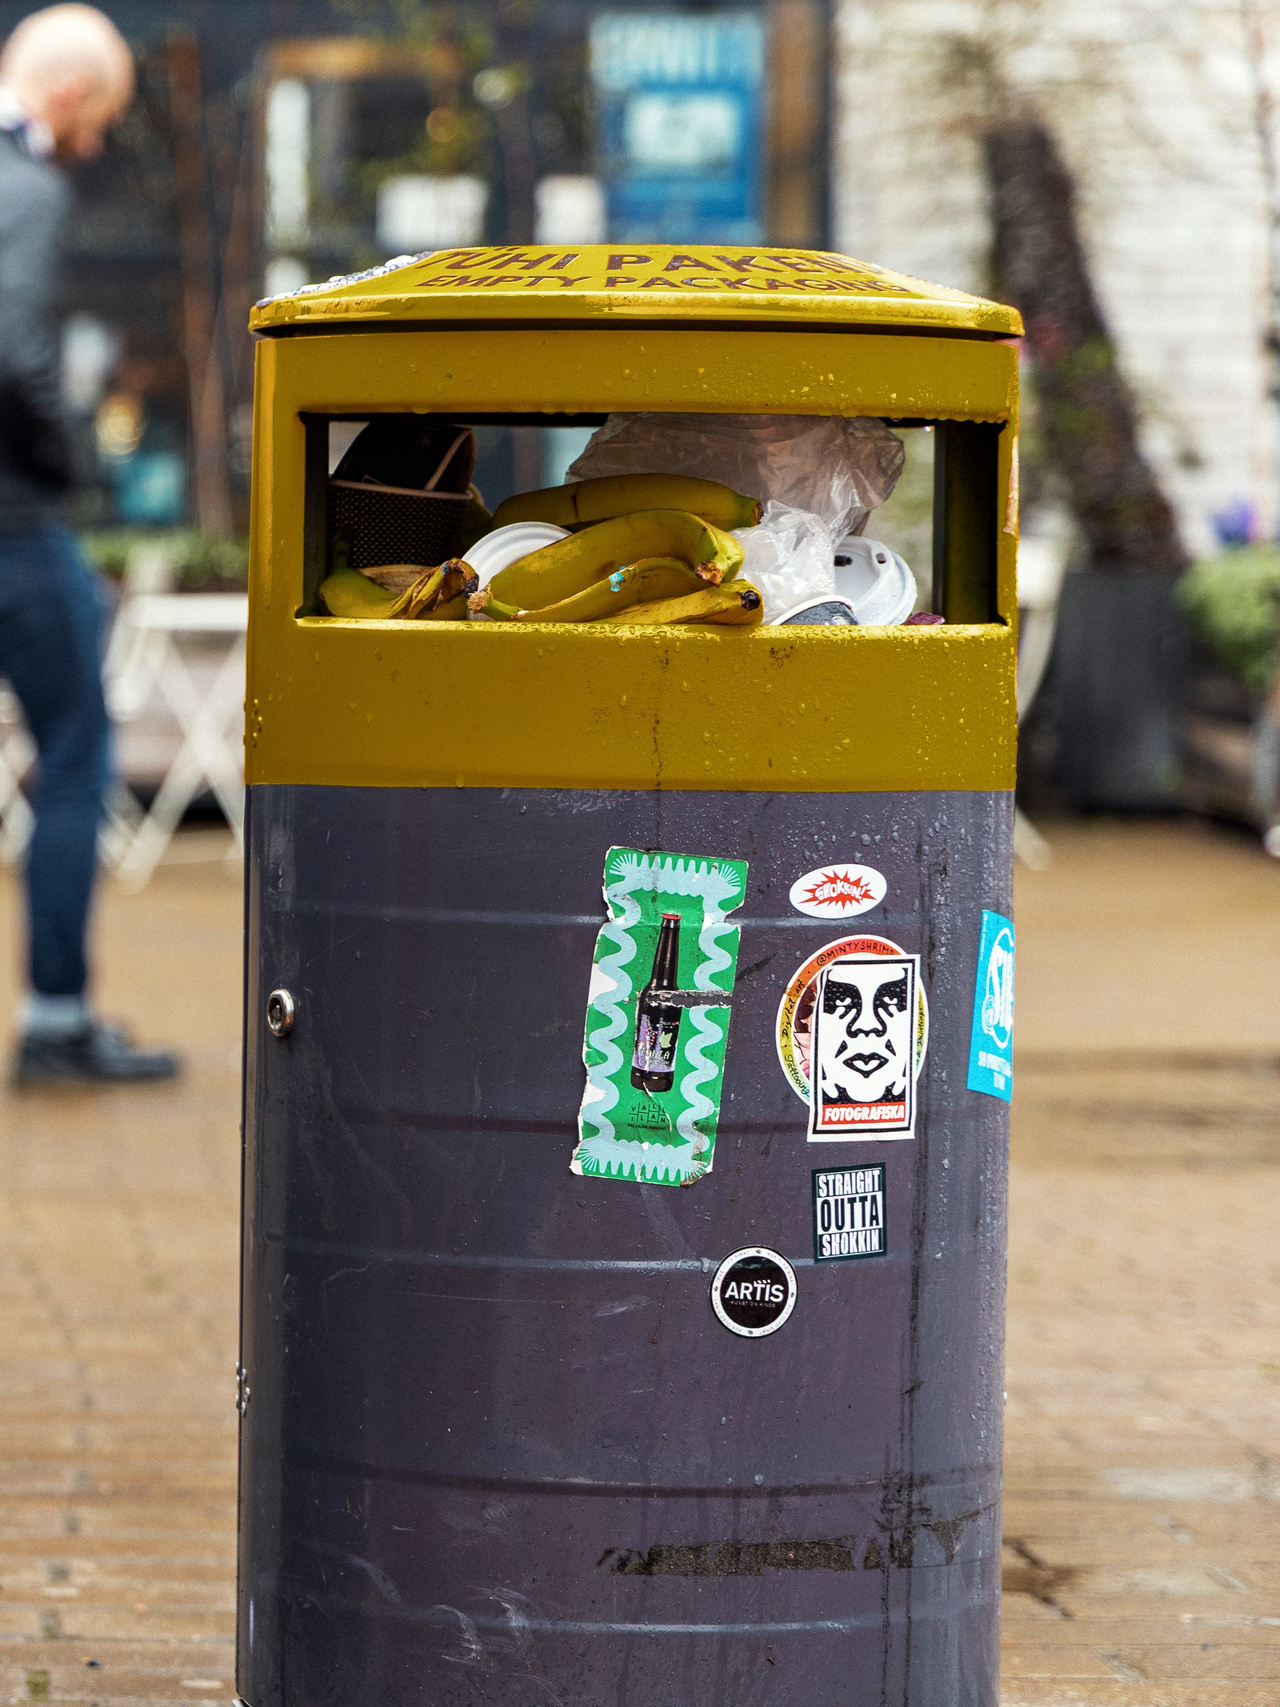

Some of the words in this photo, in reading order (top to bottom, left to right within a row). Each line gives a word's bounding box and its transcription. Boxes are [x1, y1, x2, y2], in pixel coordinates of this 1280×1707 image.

[415, 246, 580, 271] TÜHI
[414, 275, 592, 288] EMPTY
[604, 276, 910, 293] PACKAGING
[824, 1105, 904, 1122] FOTOGRAFISKA
[818, 1169, 880, 1197] STRAIGHT
[820, 1194, 880, 1232] OUTTA
[822, 1229, 879, 1256] SHOKKIN
